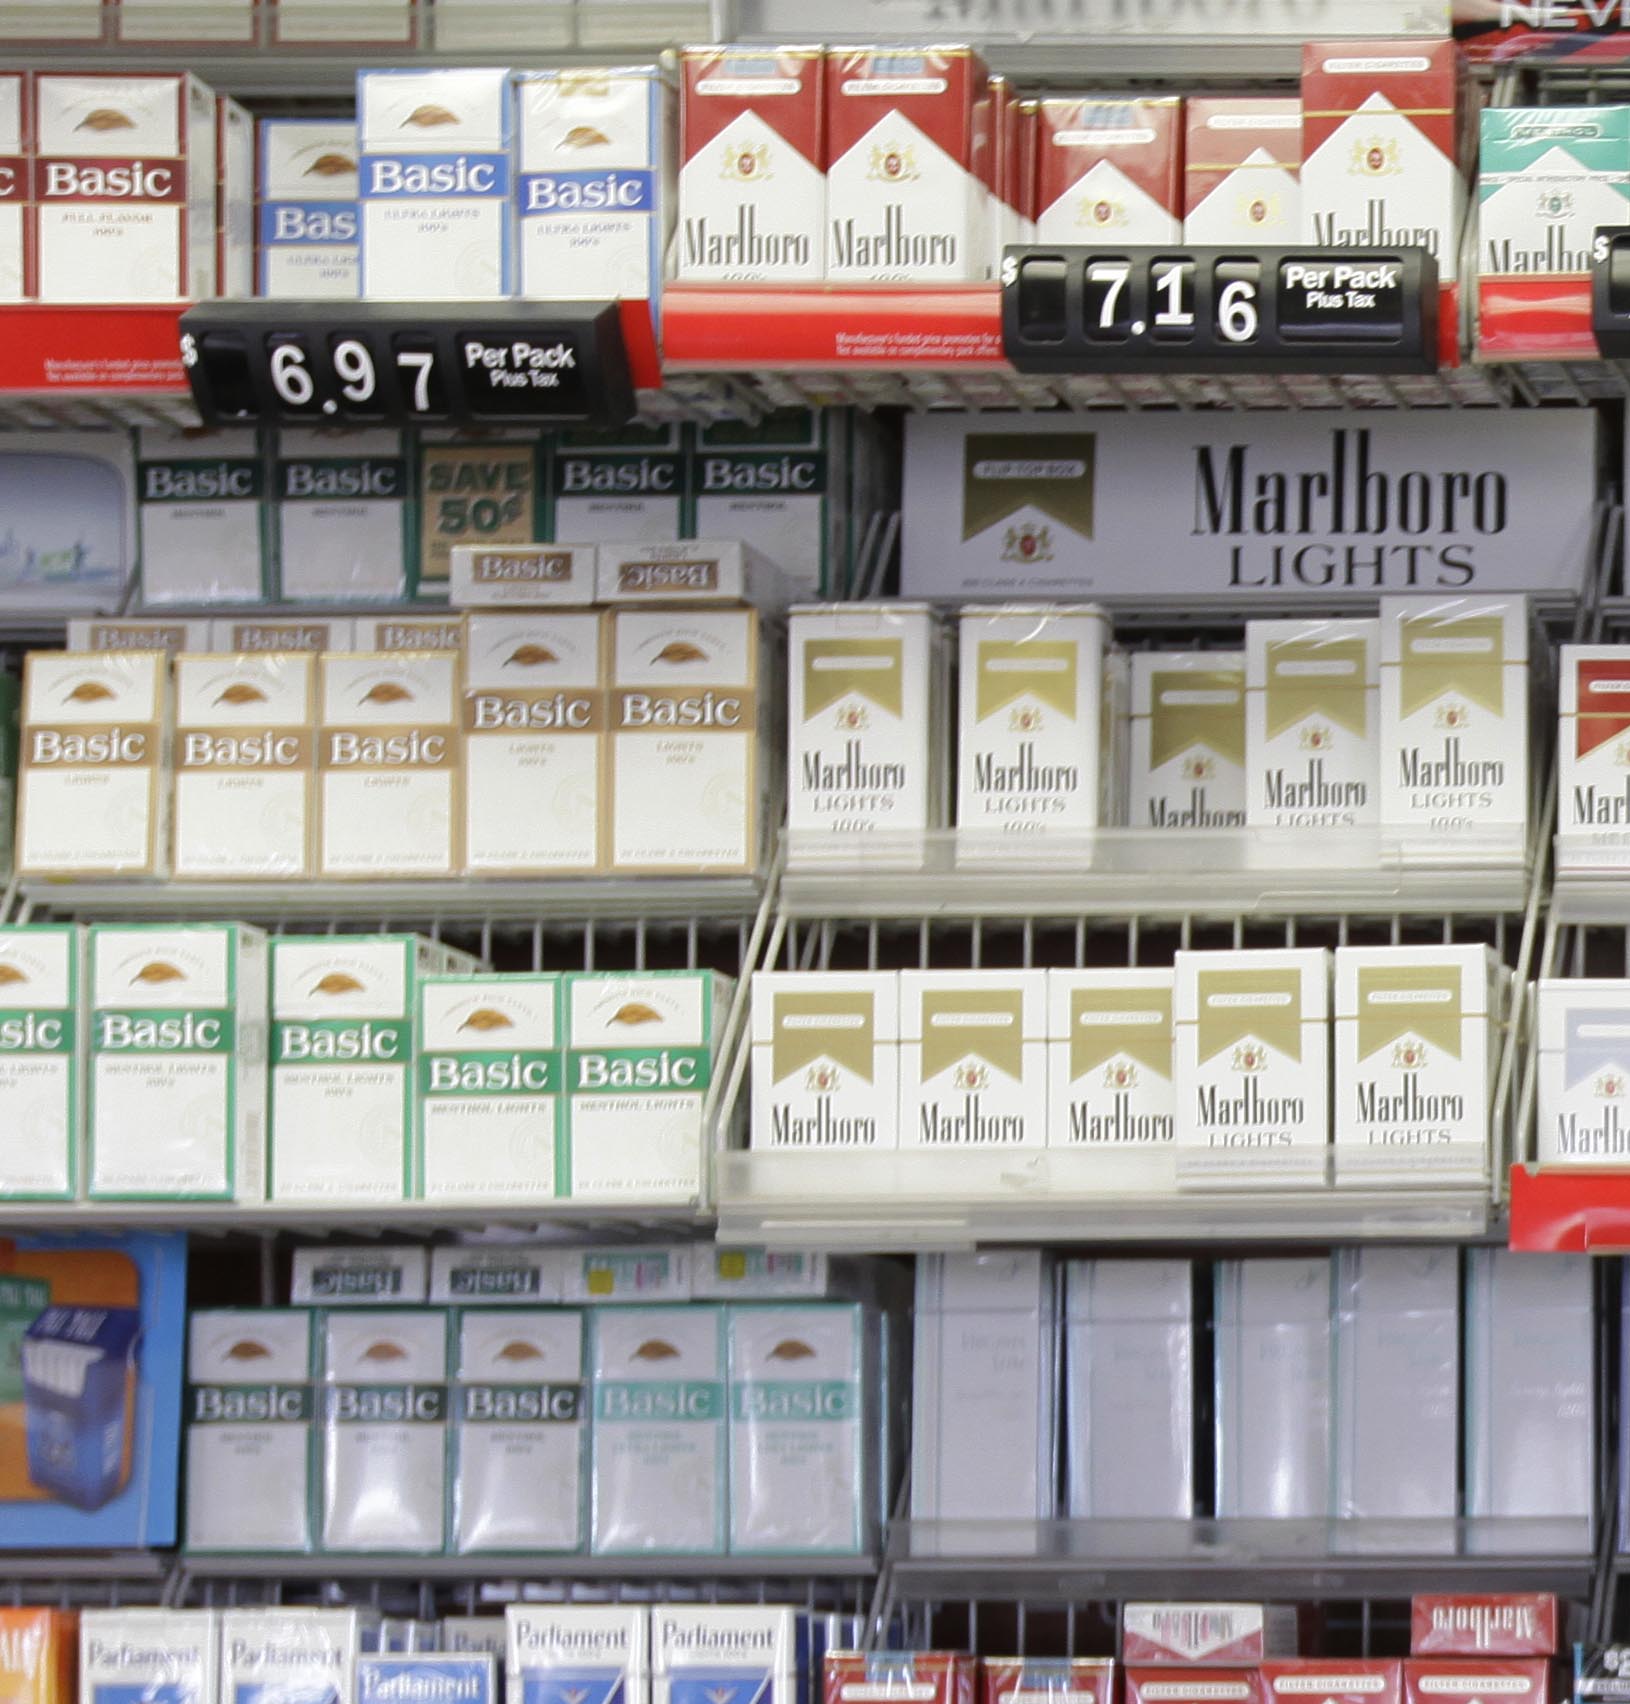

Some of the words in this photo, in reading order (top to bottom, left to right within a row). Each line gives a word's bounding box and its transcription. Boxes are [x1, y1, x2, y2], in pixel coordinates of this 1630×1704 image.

[371, 153, 494, 192] Basic
[832, 205, 956, 266] Marlboro
[1286, 266, 1327, 289] Per
[1334, 266, 1395, 289] Pack
[1091, 268, 1257, 341] 7.16
[1306, 292, 1343, 309] Plus
[1346, 292, 1374, 309] Tax
[466, 342, 508, 370] Per
[512, 344, 574, 369] Pack
[271, 341, 434, 414] 6.97
[490, 370, 524, 387] Plus
[529, 371, 559, 388] Tax
[146, 461, 252, 498] Basic
[427, 462, 531, 492] SAVE
[702, 459, 815, 490] Basic
[1190, 428, 1508, 537] Marlboro
[1229, 544, 1475, 588] LIGHTS
[619, 694, 741, 727] Basic
[183, 732, 299, 766] Basic
[1264, 760, 1366, 809] Marlboro
[813, 794, 895, 813] LIGHTS
[280, 1025, 398, 1059] Basic
[1356, 1074, 1464, 1123] Marlboro
[920, 1095, 1025, 1143] Marlboro
[195, 1387, 301, 1419] Basic
[465, 1385, 572, 1418] Basic
[516, 1623, 628, 1652] Parliament
